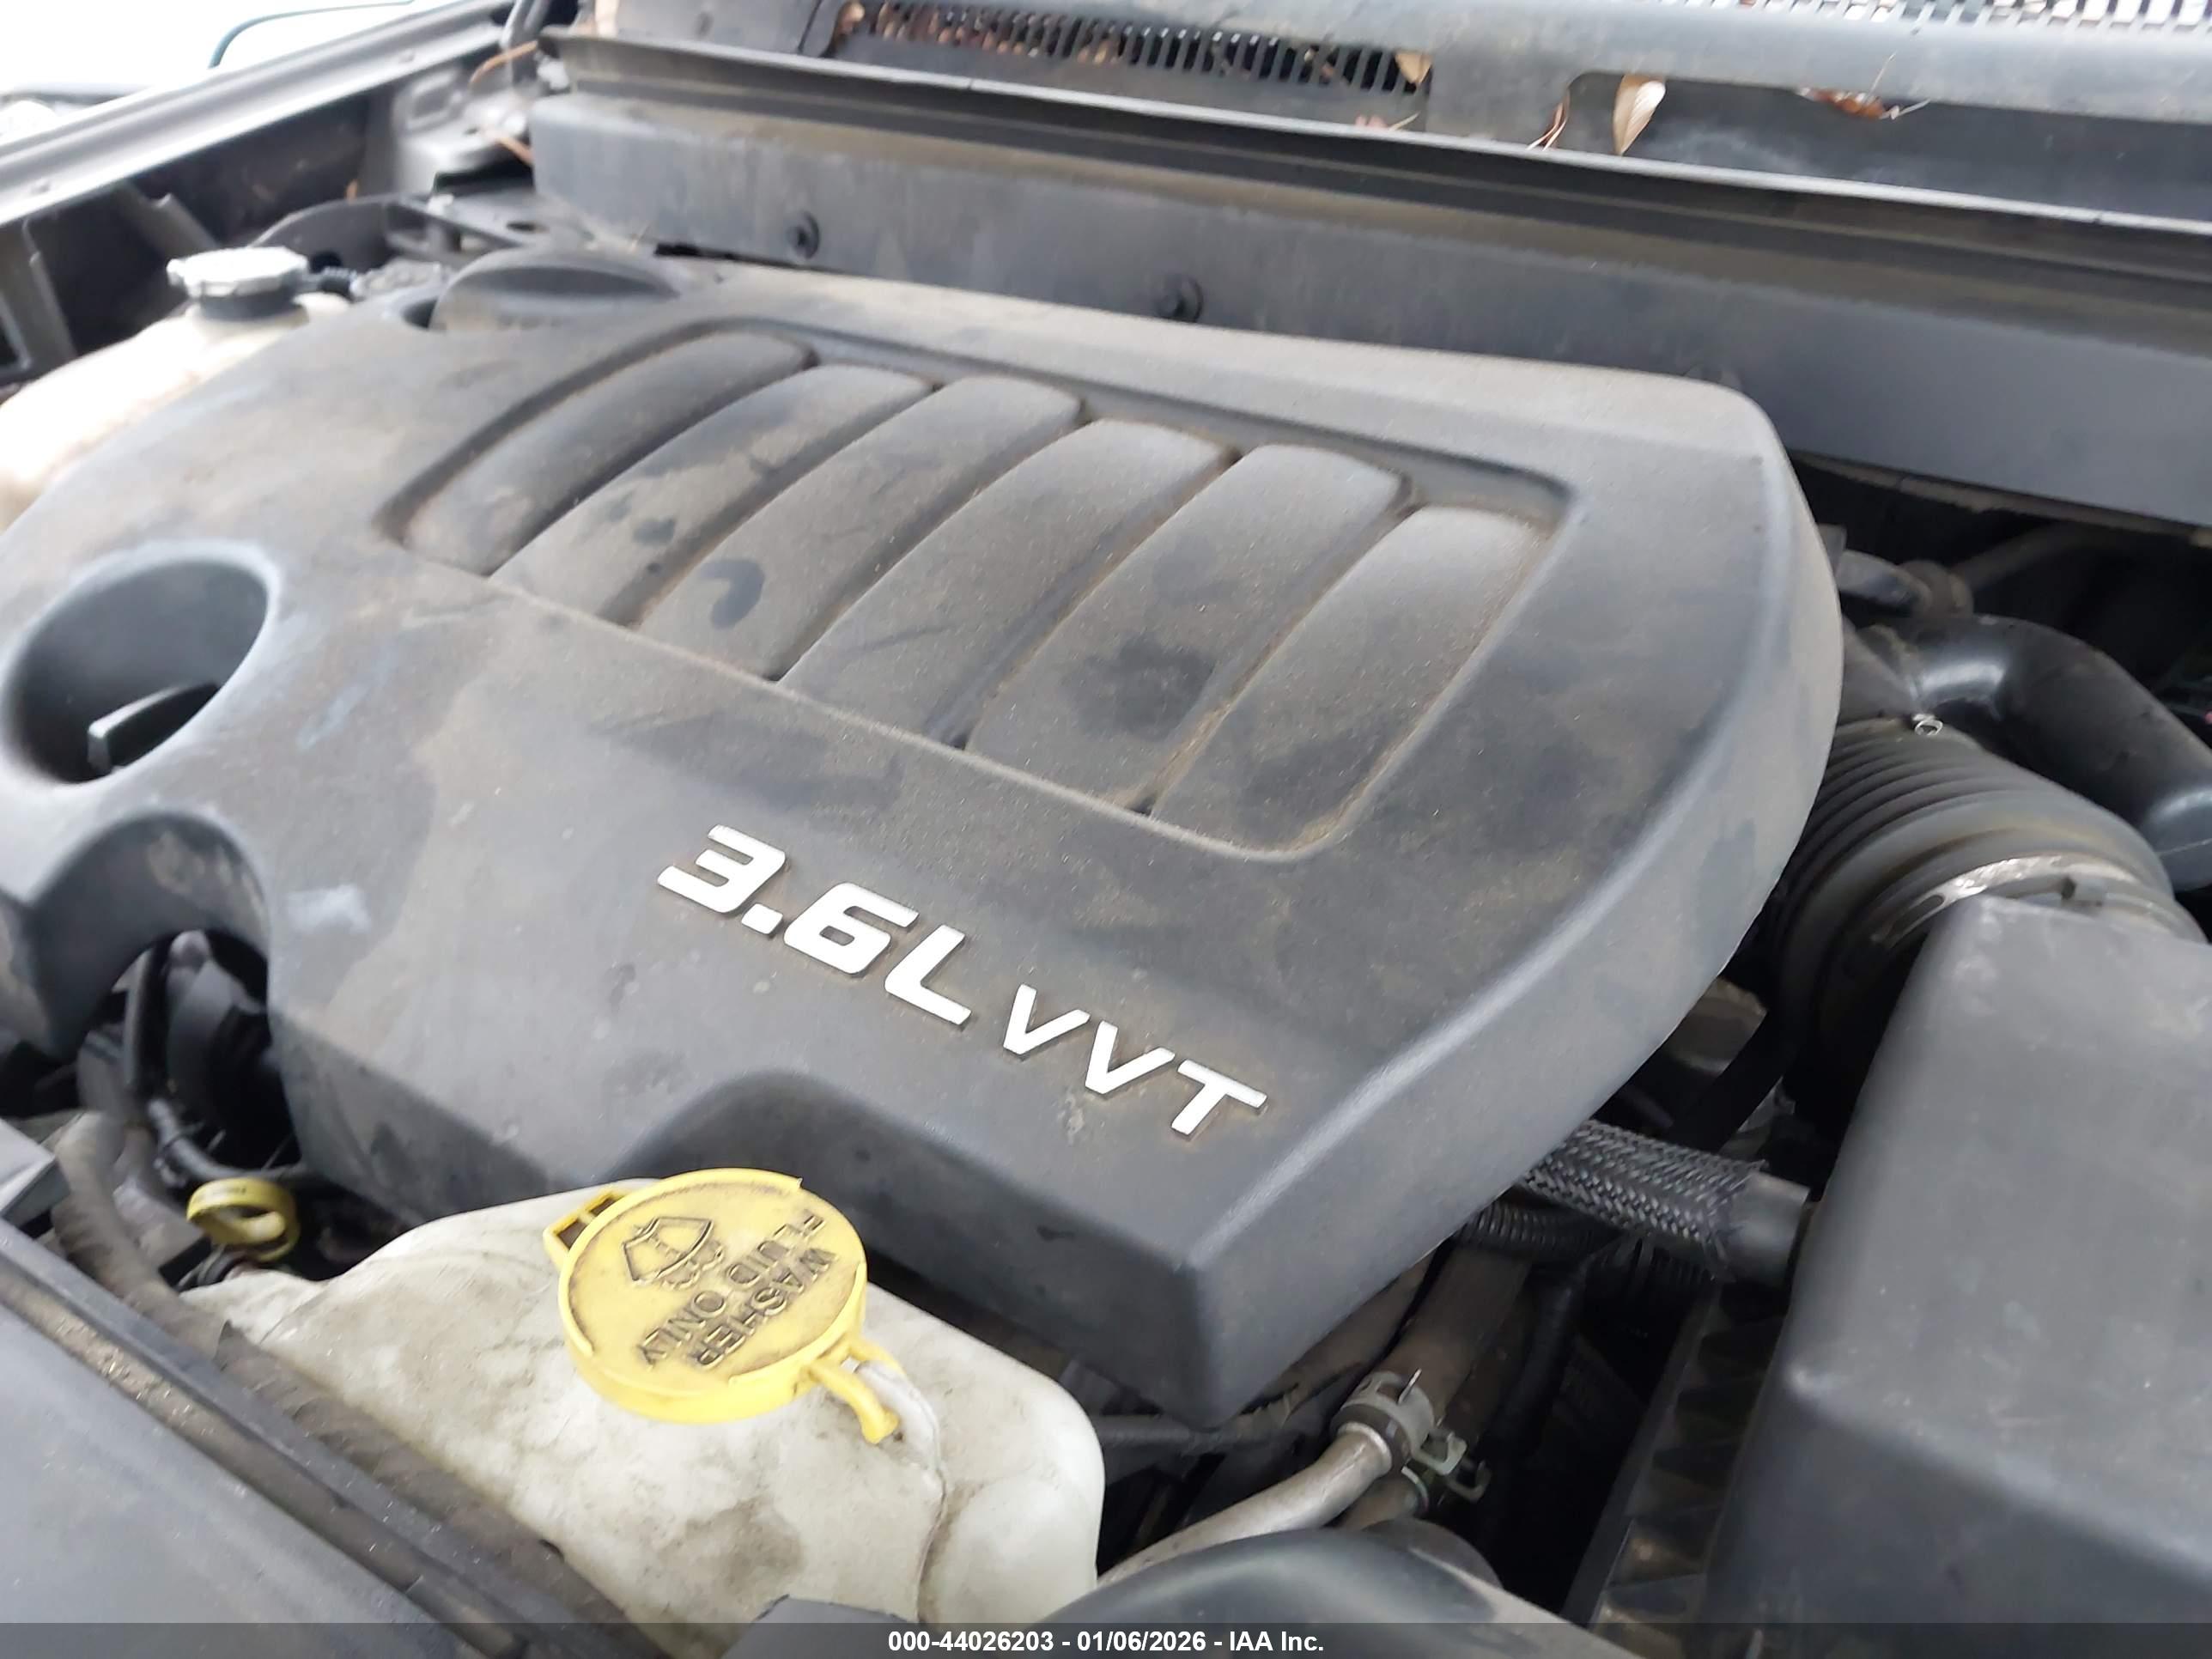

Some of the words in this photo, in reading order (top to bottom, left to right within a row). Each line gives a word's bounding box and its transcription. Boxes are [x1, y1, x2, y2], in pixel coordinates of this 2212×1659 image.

[657, 824, 971, 1025] 3.6L
[1003, 983, 1268, 1136] VVT
[725, 1208, 825, 1288] FLUID
[636, 1288, 728, 1369] ONLY
[690, 1247, 838, 1368] WASHER
